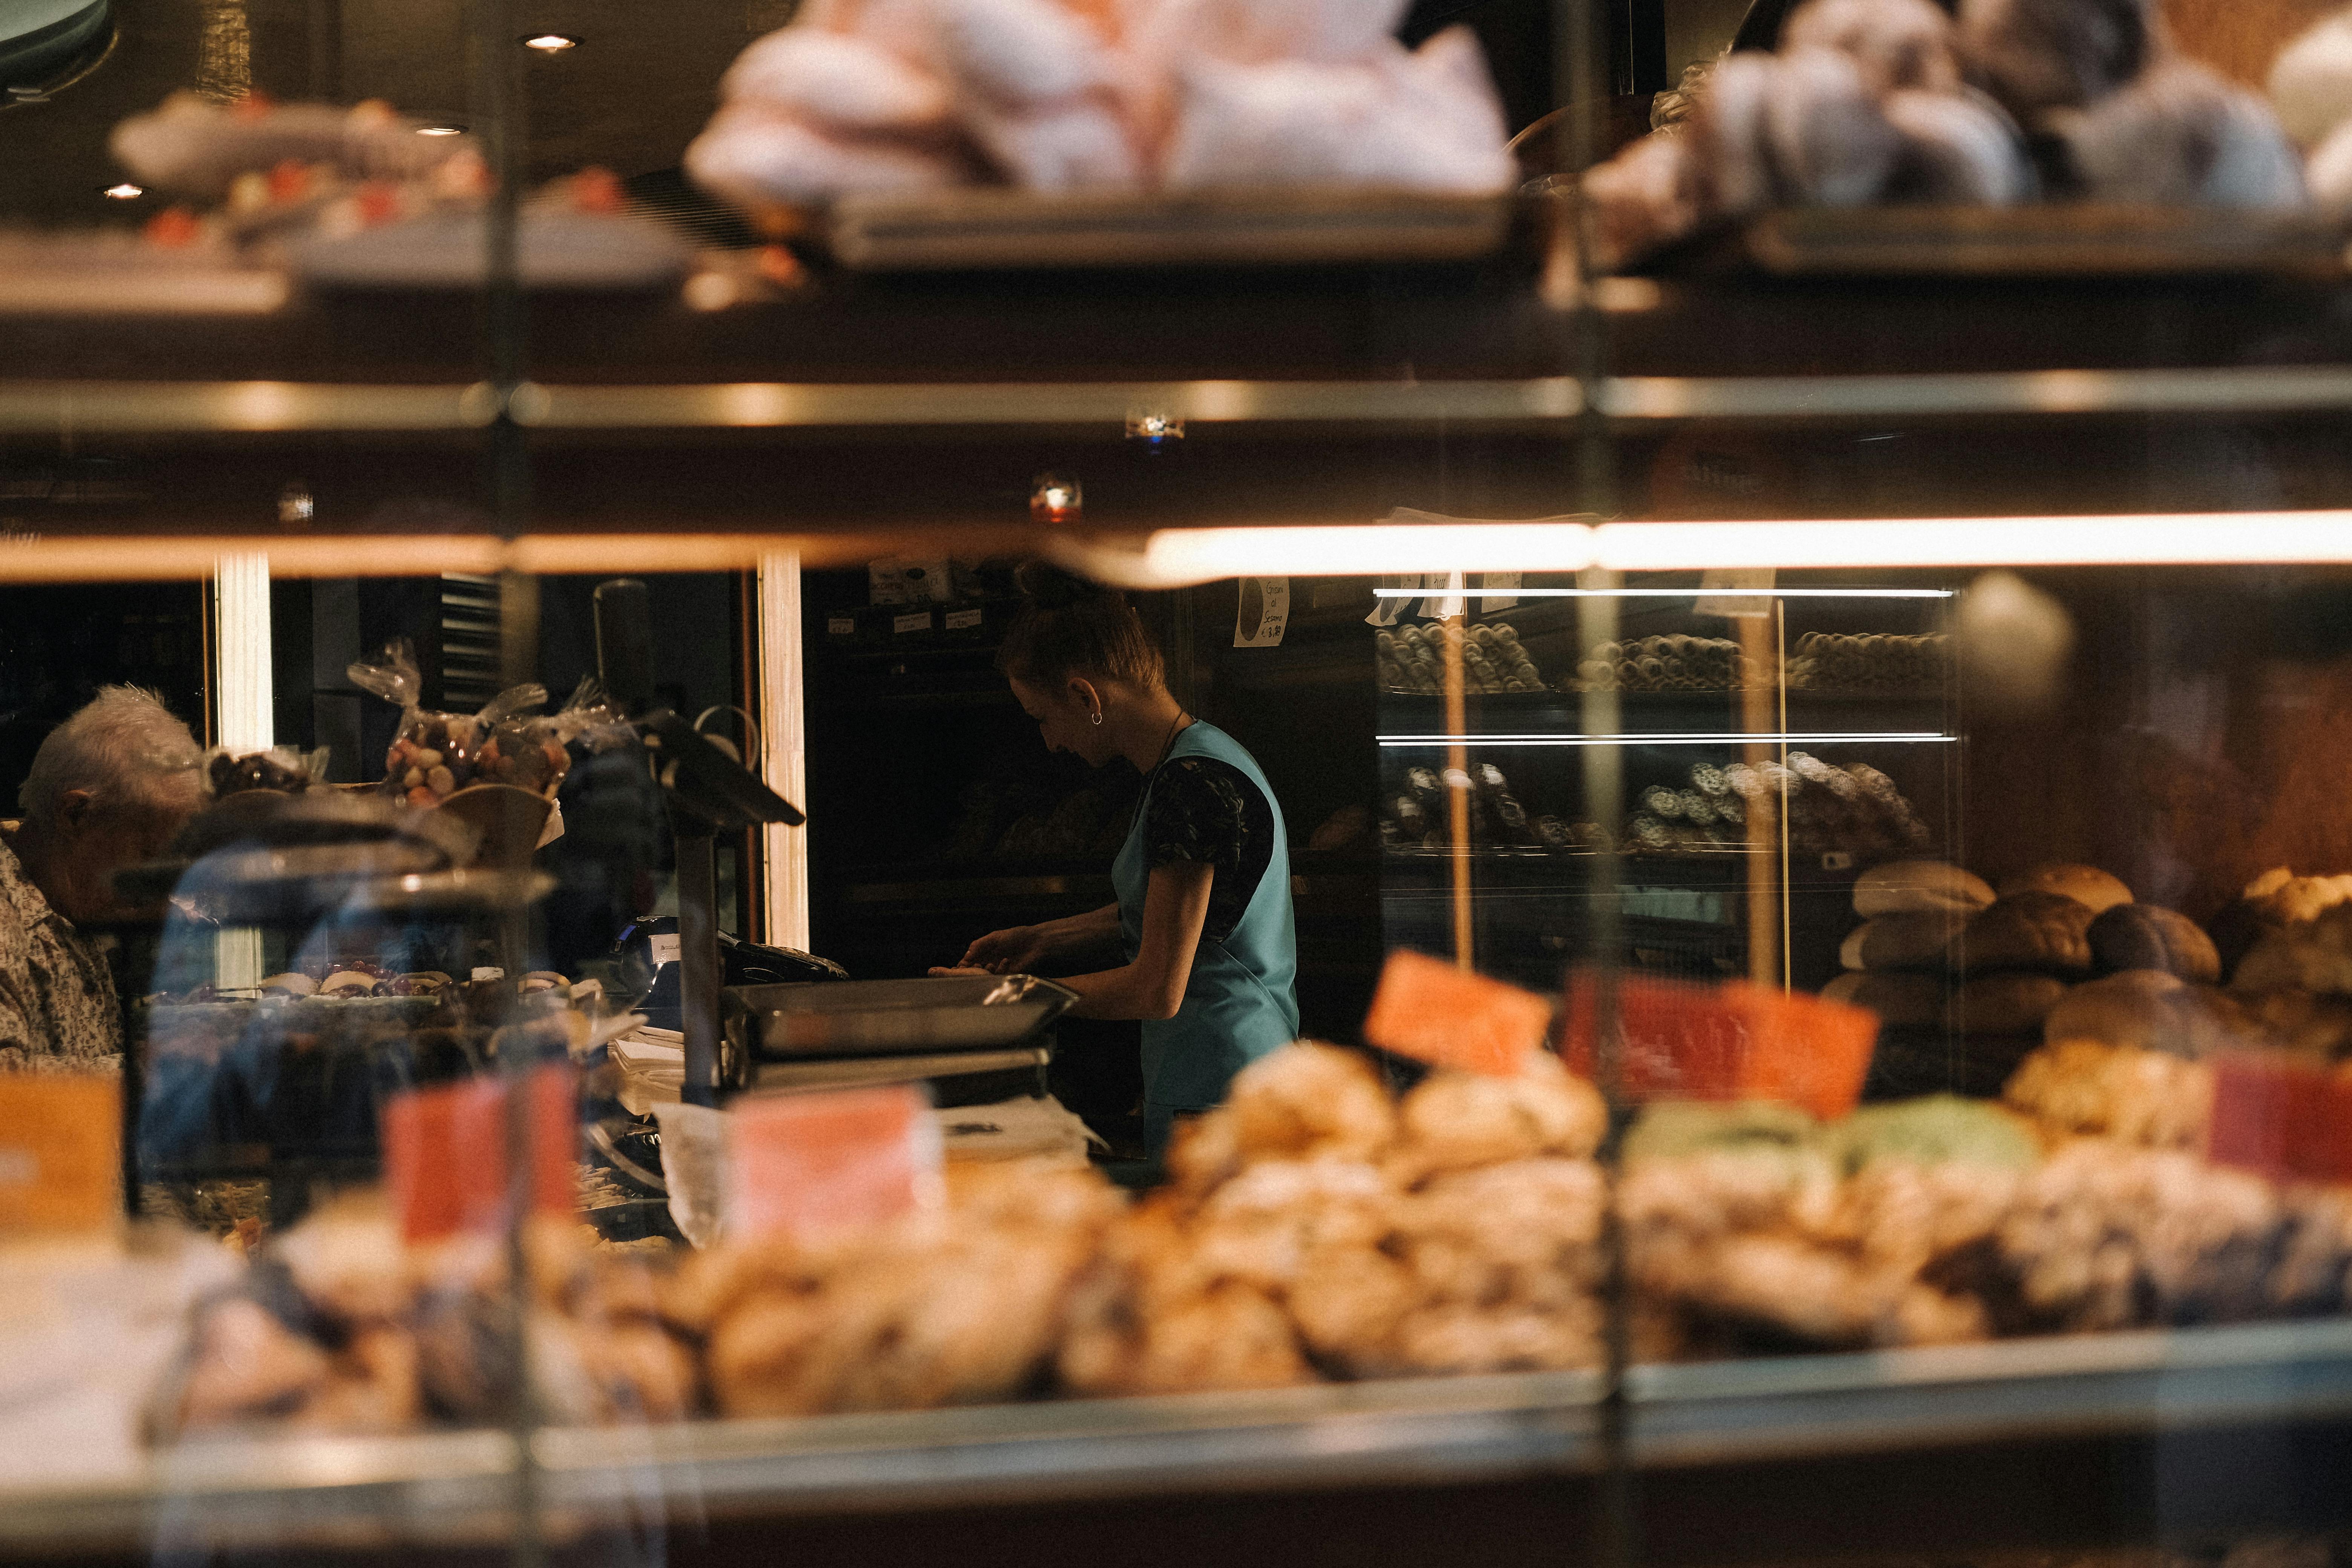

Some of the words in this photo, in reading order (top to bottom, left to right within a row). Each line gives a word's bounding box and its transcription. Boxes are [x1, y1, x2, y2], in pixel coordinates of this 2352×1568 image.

[1266, 581, 1283, 596] Grissini
[1271, 598, 1277, 607] al
[1264, 611, 1282, 623] Sesamo
